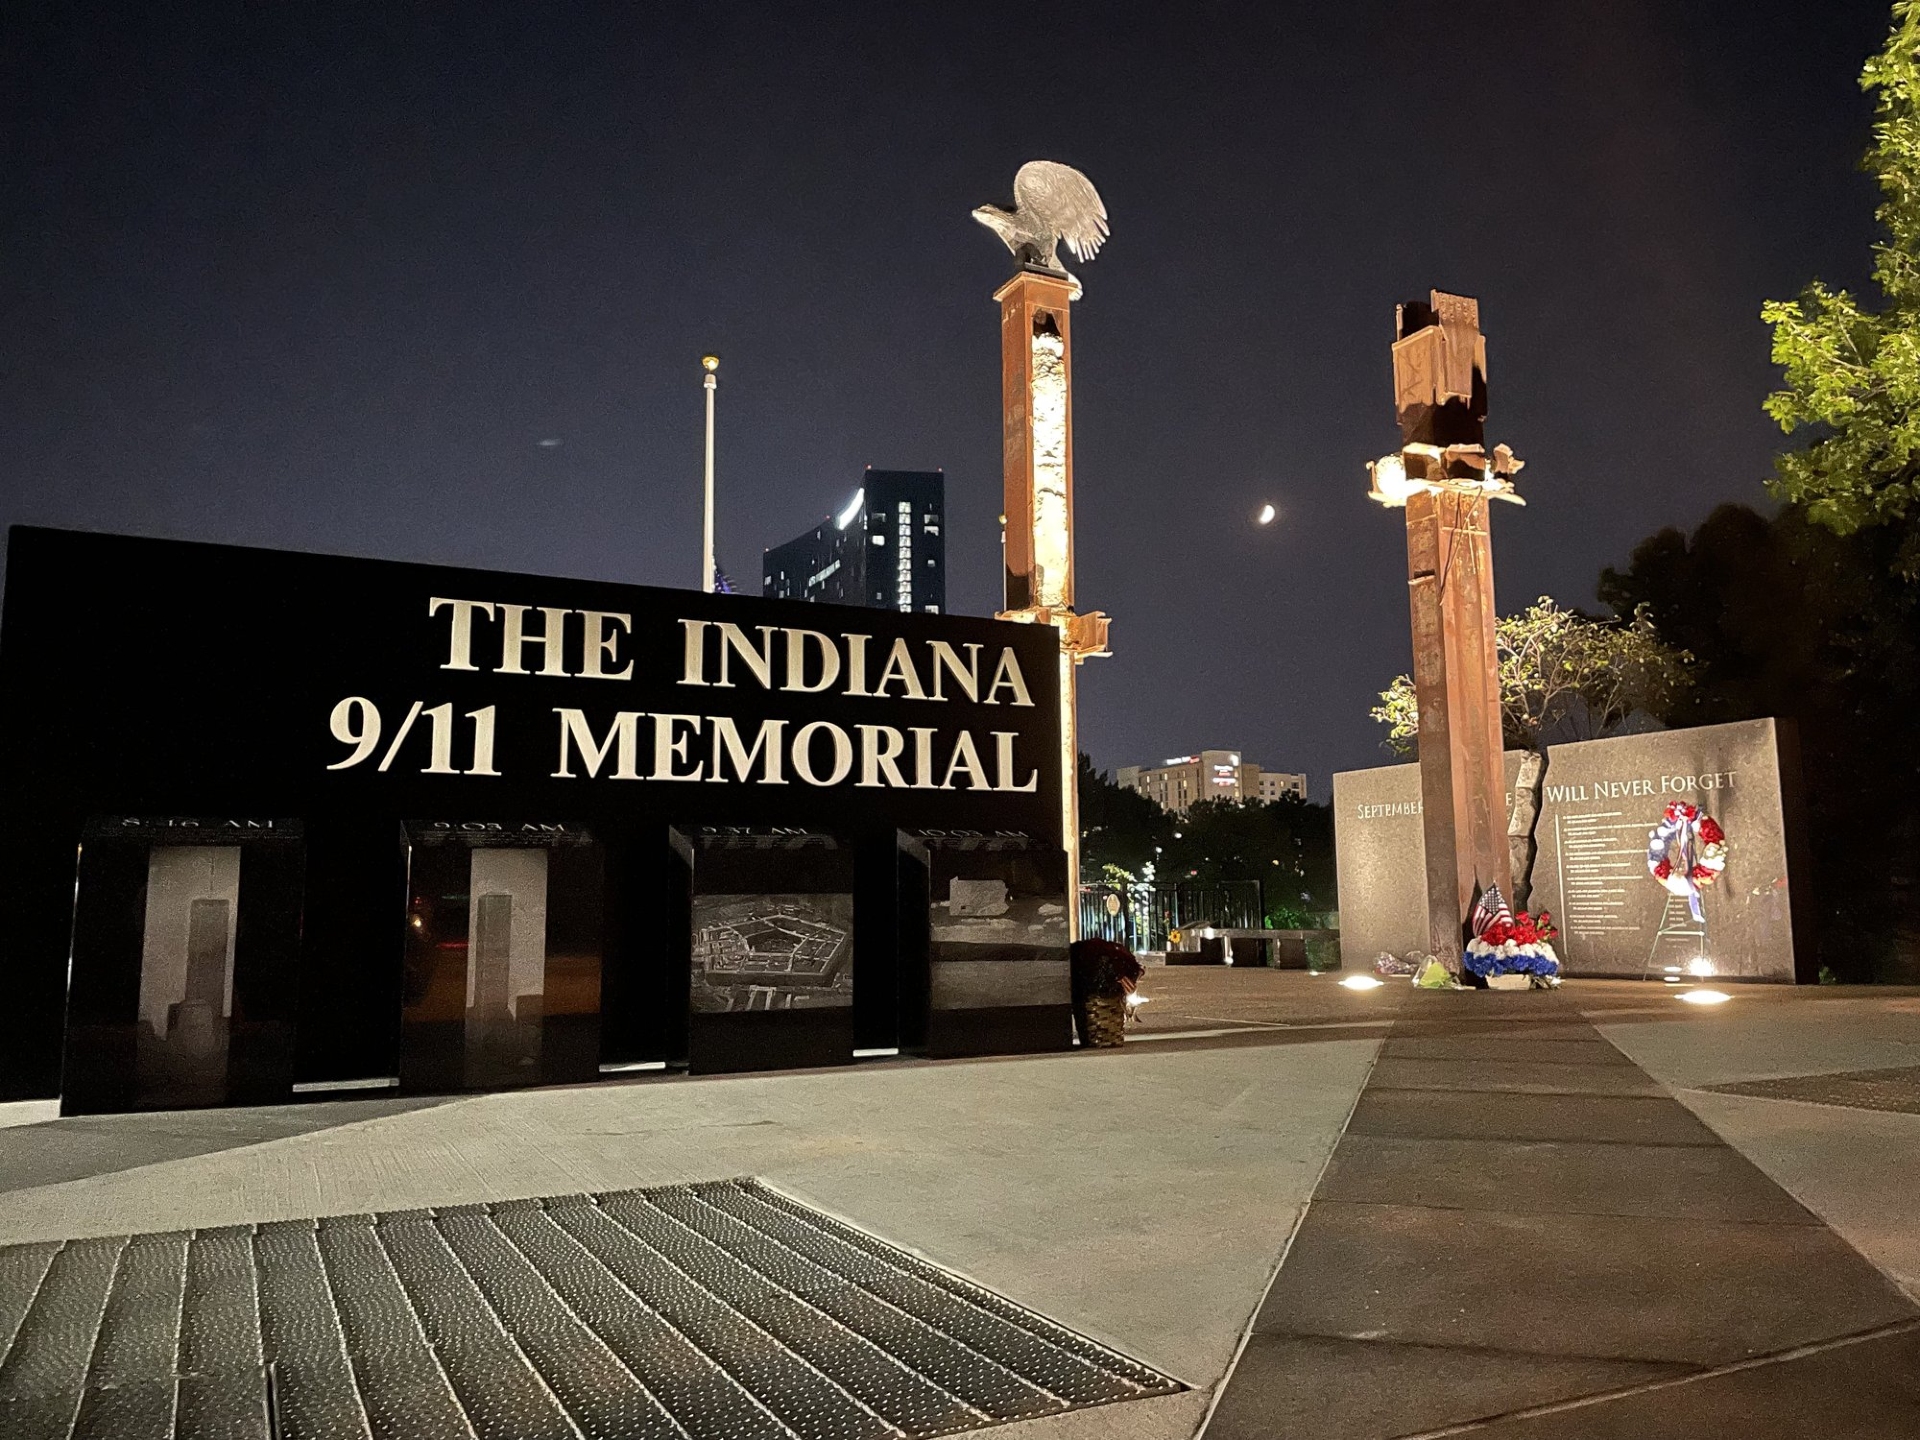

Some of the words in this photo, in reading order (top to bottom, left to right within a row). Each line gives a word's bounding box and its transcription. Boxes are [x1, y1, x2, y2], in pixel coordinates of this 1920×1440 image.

[429, 597, 635, 681] THE
[676, 618, 1036, 707] INDIANA
[326, 696, 502, 777] 9/11
[550, 707, 1038, 793] MEMORIAL
[1547, 785, 1588, 802] WILL
[1594, 779, 1655, 800] NEVER
[1661, 771, 1737, 794] FORGET
[521, 823, 565, 831] AM
